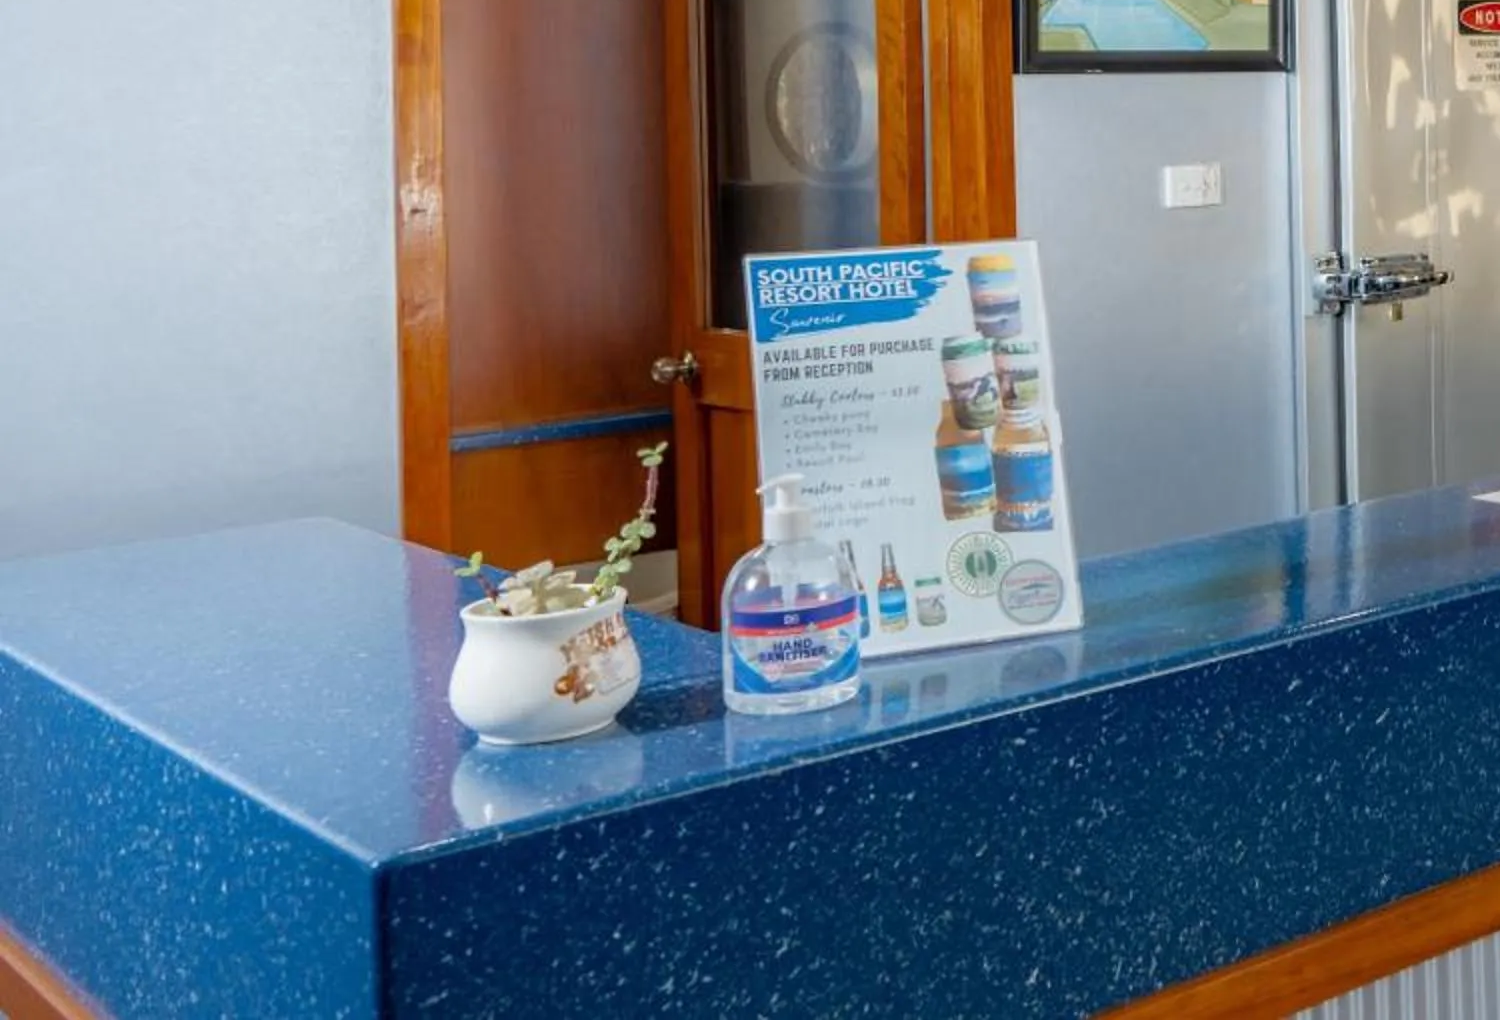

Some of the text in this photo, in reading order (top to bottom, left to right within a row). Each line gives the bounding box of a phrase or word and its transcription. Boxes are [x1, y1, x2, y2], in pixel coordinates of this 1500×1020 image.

[757, 259, 925, 286] SOUTH PACIFIC
[759, 280, 918, 306] RESORT HOTEL
[763, 337, 934, 365] AVAILABLE FOR PURCHASE
[763, 359, 875, 383] FROM RECEPTION
[773, 637, 813, 652] HAND
